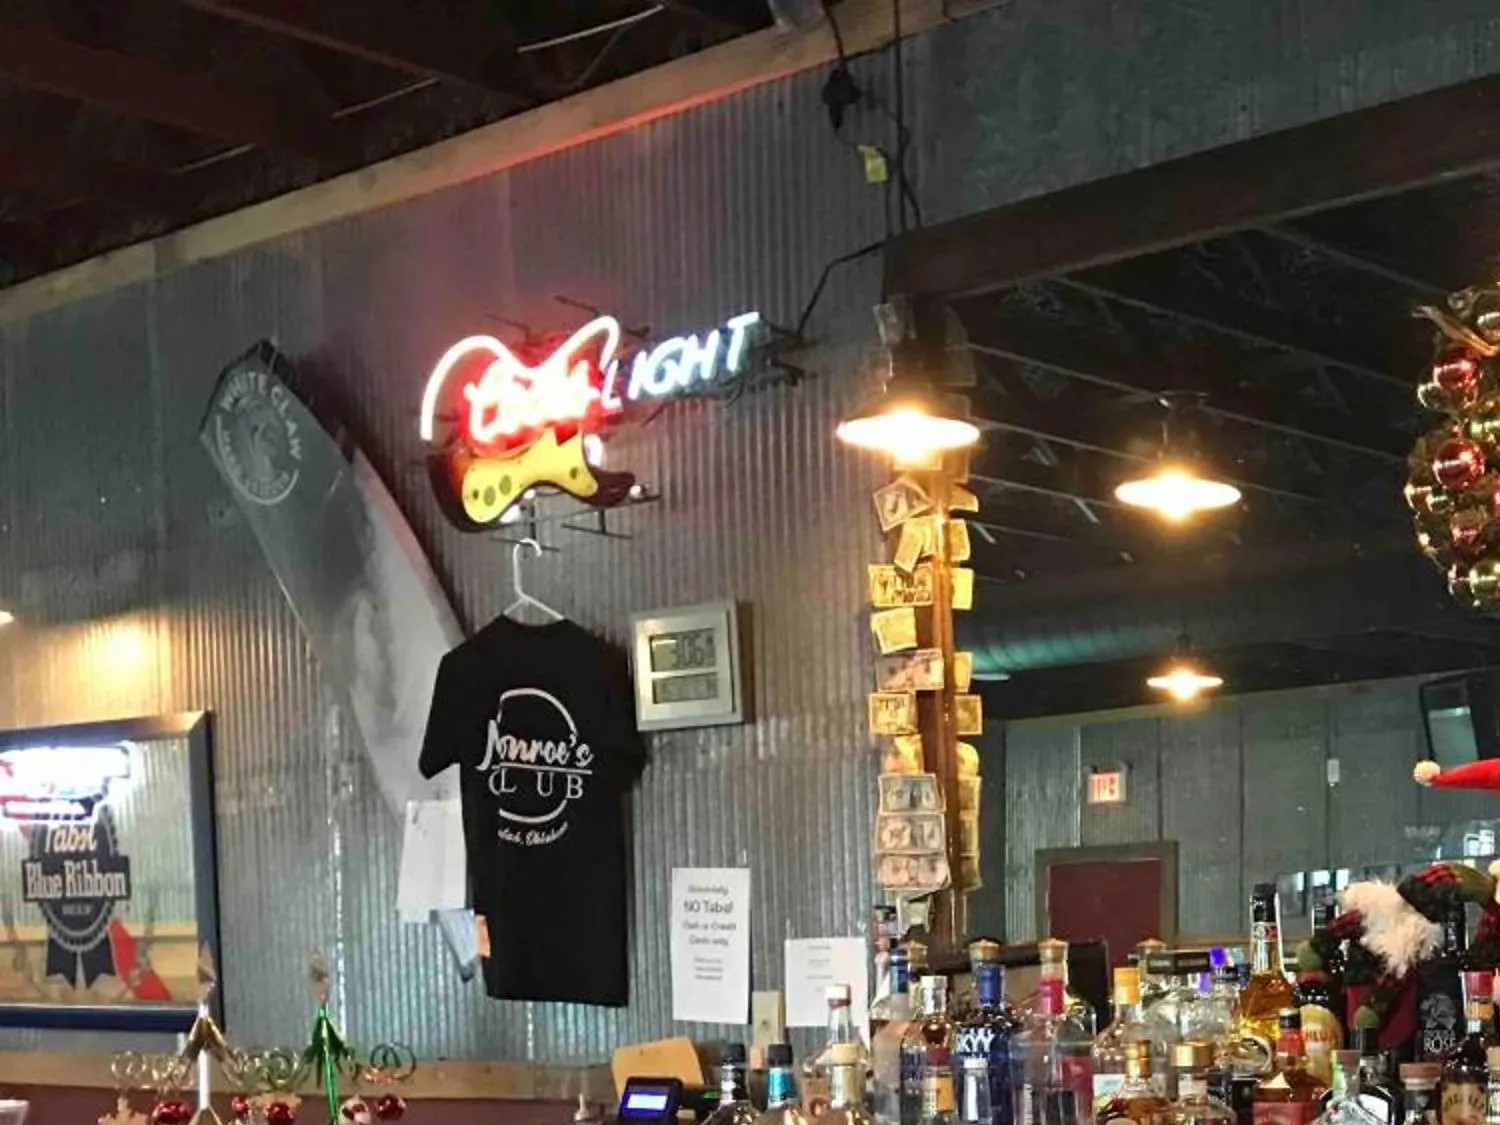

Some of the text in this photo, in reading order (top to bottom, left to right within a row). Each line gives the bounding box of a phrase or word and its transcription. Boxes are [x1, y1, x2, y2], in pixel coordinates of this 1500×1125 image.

[601, 311, 761, 411] LIGHT
[488, 767, 584, 799] CLUB
[25, 859, 128, 899] Blue Ribbon
[683, 900, 701, 914] NO
